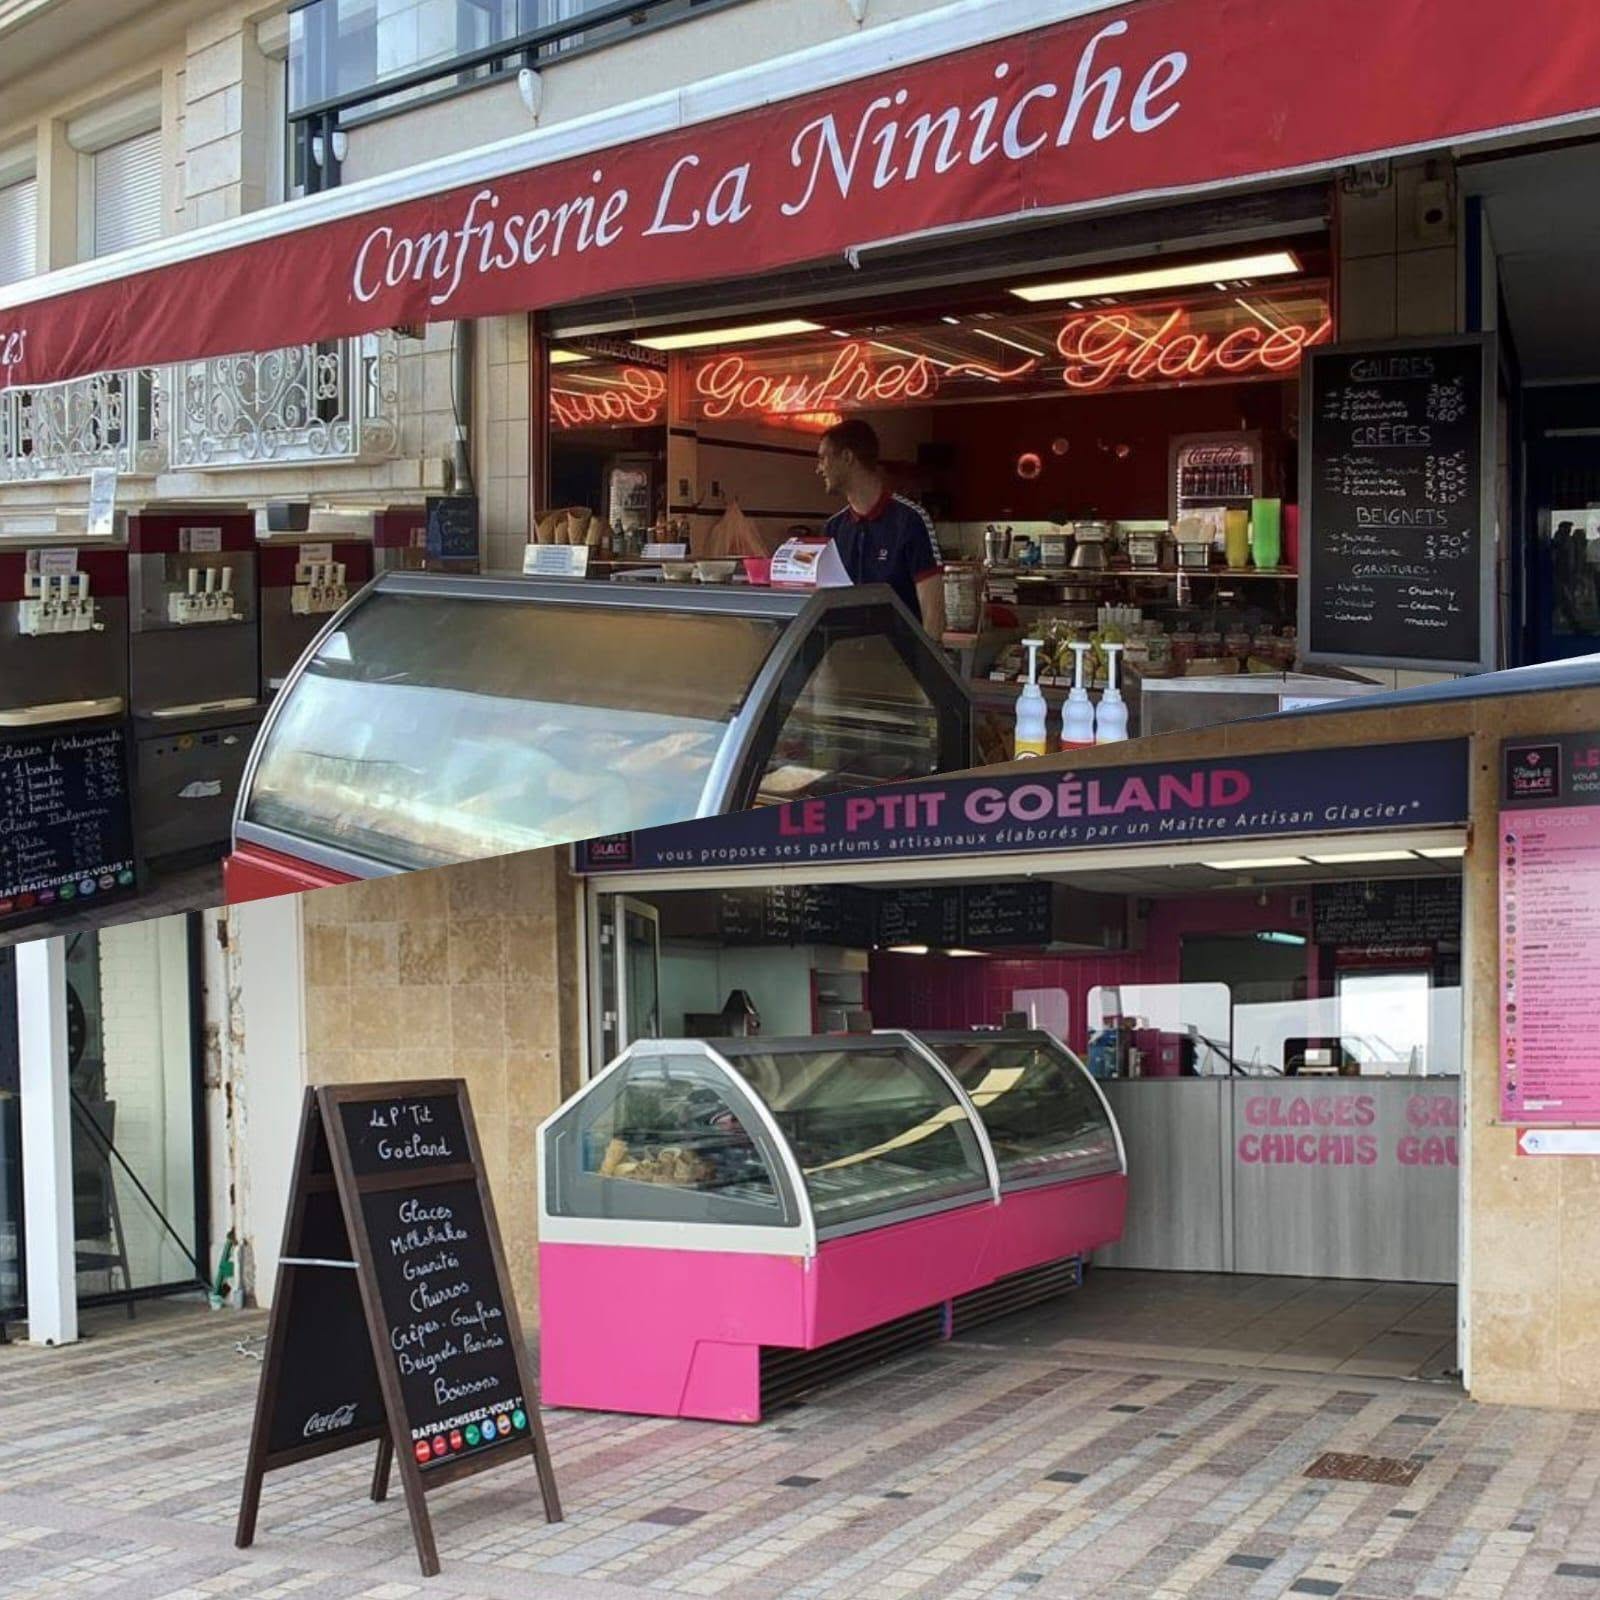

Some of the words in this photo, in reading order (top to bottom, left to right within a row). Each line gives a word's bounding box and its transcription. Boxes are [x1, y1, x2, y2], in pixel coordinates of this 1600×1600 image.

[353, 169, 628, 305] Confiserie
[641, 155, 751, 236] La
[781, 20, 1188, 216] Niniche
[0, 329, 27, 366] es
[696, 343, 937, 418] Gaufres
[1350, 357, 1435, 379] GAUFRES
[1351, 422, 1431, 444] CRÊPES
[1356, 506, 1448, 525] BEIGNETS
[778, 801, 827, 836] LE
[846, 791, 946, 832] PTIT
[963, 769, 1252, 825] GOÉLAND
[656, 849, 694, 862] vous
[701, 845, 767, 865] propose
[775, 843, 801, 856] ses
[809, 837, 881, 857] parfums
[889, 832, 987, 850] artisanaux
[996, 826, 1077, 844] élaborés
[1086, 825, 1118, 841] par
[1127, 822, 1149, 835] un
[1159, 815, 1226, 832] Maître
[1235, 810, 1313, 828] Artisan
[370, 1108, 388, 1127] Le
[1244, 1095, 1376, 1127] GLACES
[1237, 1133, 1378, 1166] CHICHIS
[400, 1199, 453, 1223] Glaces
[390, 1221, 468, 1256] Milkshakes
[410, 1281, 470, 1312] Churros
[391, 1320, 440, 1350] Crêpes
[450, 1300, 502, 1331] Gaufres
[433, 1376, 500, 1406] Boissons
[303, 1403, 359, 1437] Coca-Cola
[411, 1399, 516, 1441] RAFRAICHISSEZ-VOUS
